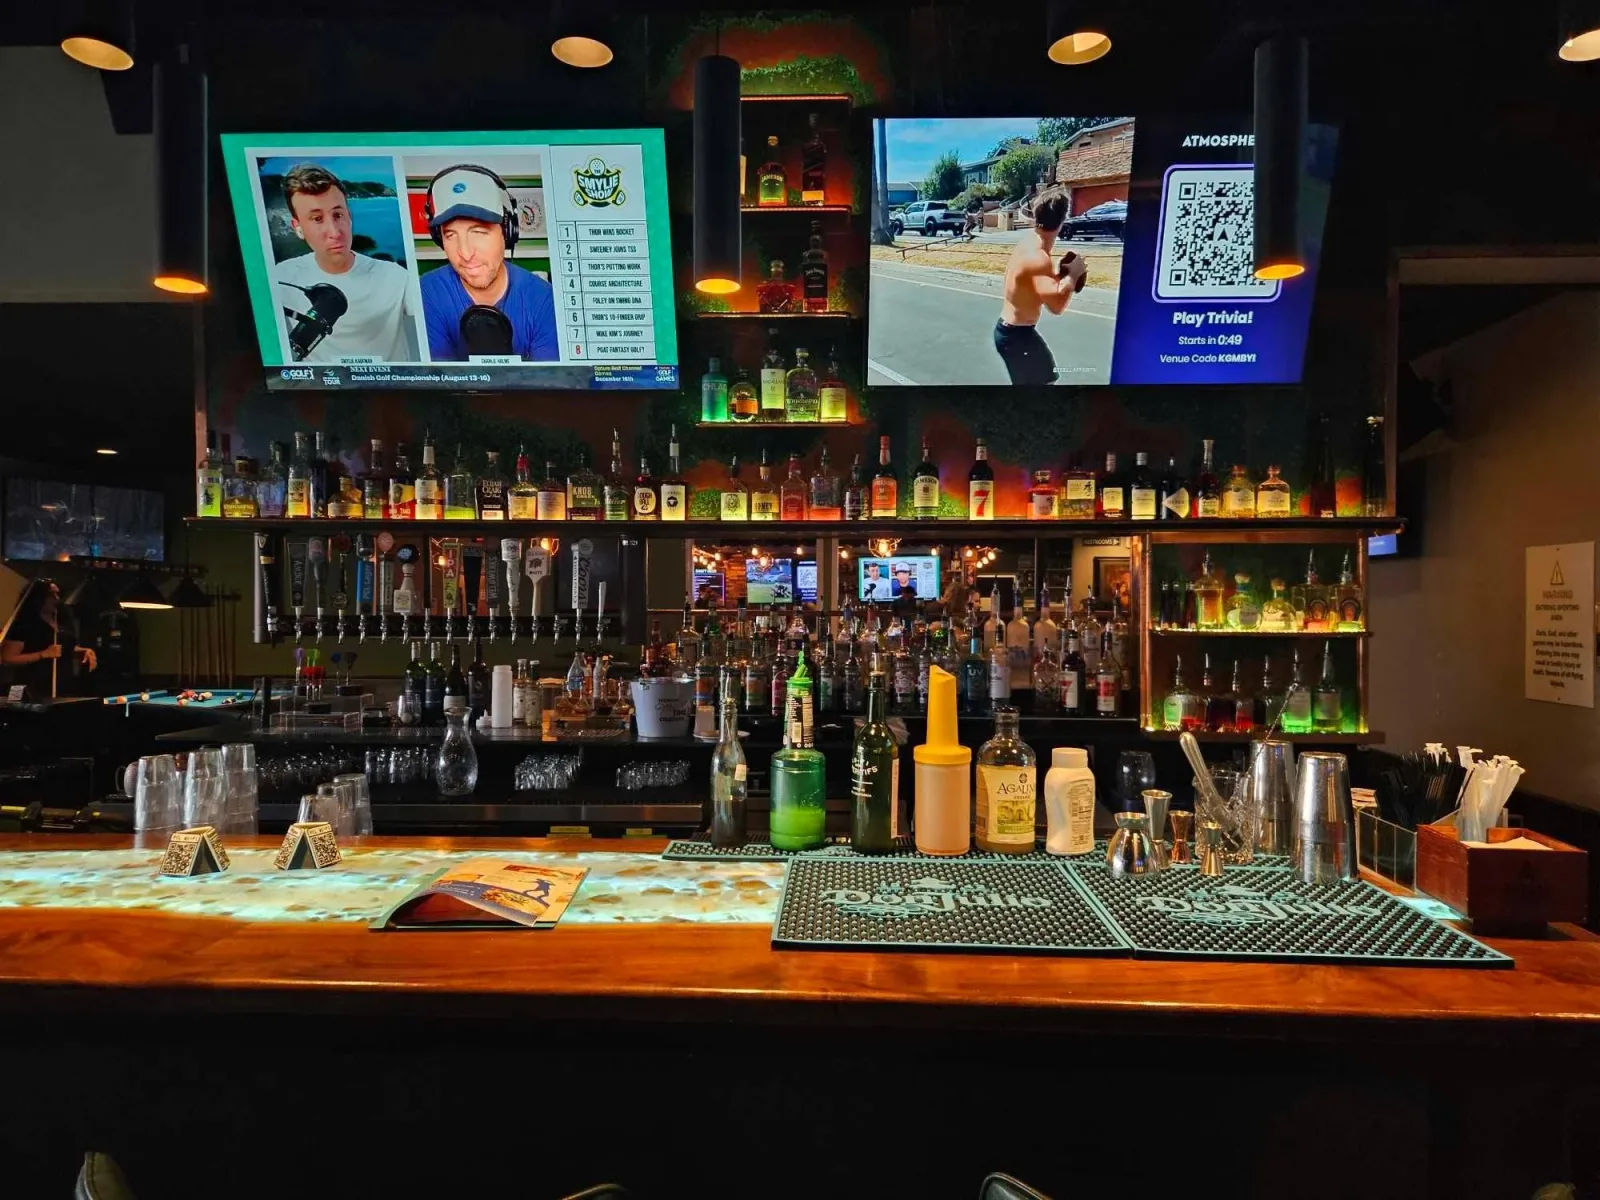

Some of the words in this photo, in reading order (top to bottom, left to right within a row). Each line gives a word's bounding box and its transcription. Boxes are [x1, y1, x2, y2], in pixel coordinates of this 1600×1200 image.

[578, 173, 619, 190] SMYLIE
[585, 187, 613, 199] SHOW
[565, 227, 569, 238] 1
[602, 228, 615, 236] WINS
[616, 228, 634, 236] ROCKET
[566, 244, 571, 255] 2
[568, 262, 573, 272] 3
[569, 279, 575, 289] 4
[571, 296, 576, 306] 5
[572, 312, 578, 322] 6
[609, 313, 634, 321] 10-FINGER
[635, 313, 645, 321] GRIP
[1172, 311, 1205, 328] Play
[1207, 310, 1254, 324] Trivia!
[574, 329, 579, 338] 7
[1178, 336, 1206, 345] Starts
[1207, 336, 1216, 345] in
[1217, 335, 1243, 346] 0:49
[575, 345, 581, 354] 8
[1159, 354, 1190, 363] Venue
[1191, 354, 1217, 363] Code
[289, 369, 309, 377] GOLF
[391, 374, 440, 382] Championship
[441, 374, 468, 382] (August
[573, 486, 592, 495] KNOB
[974, 490, 990, 517] 7
[819, 889, 932, 906] Don
[914, 890, 1052, 913] Julio
